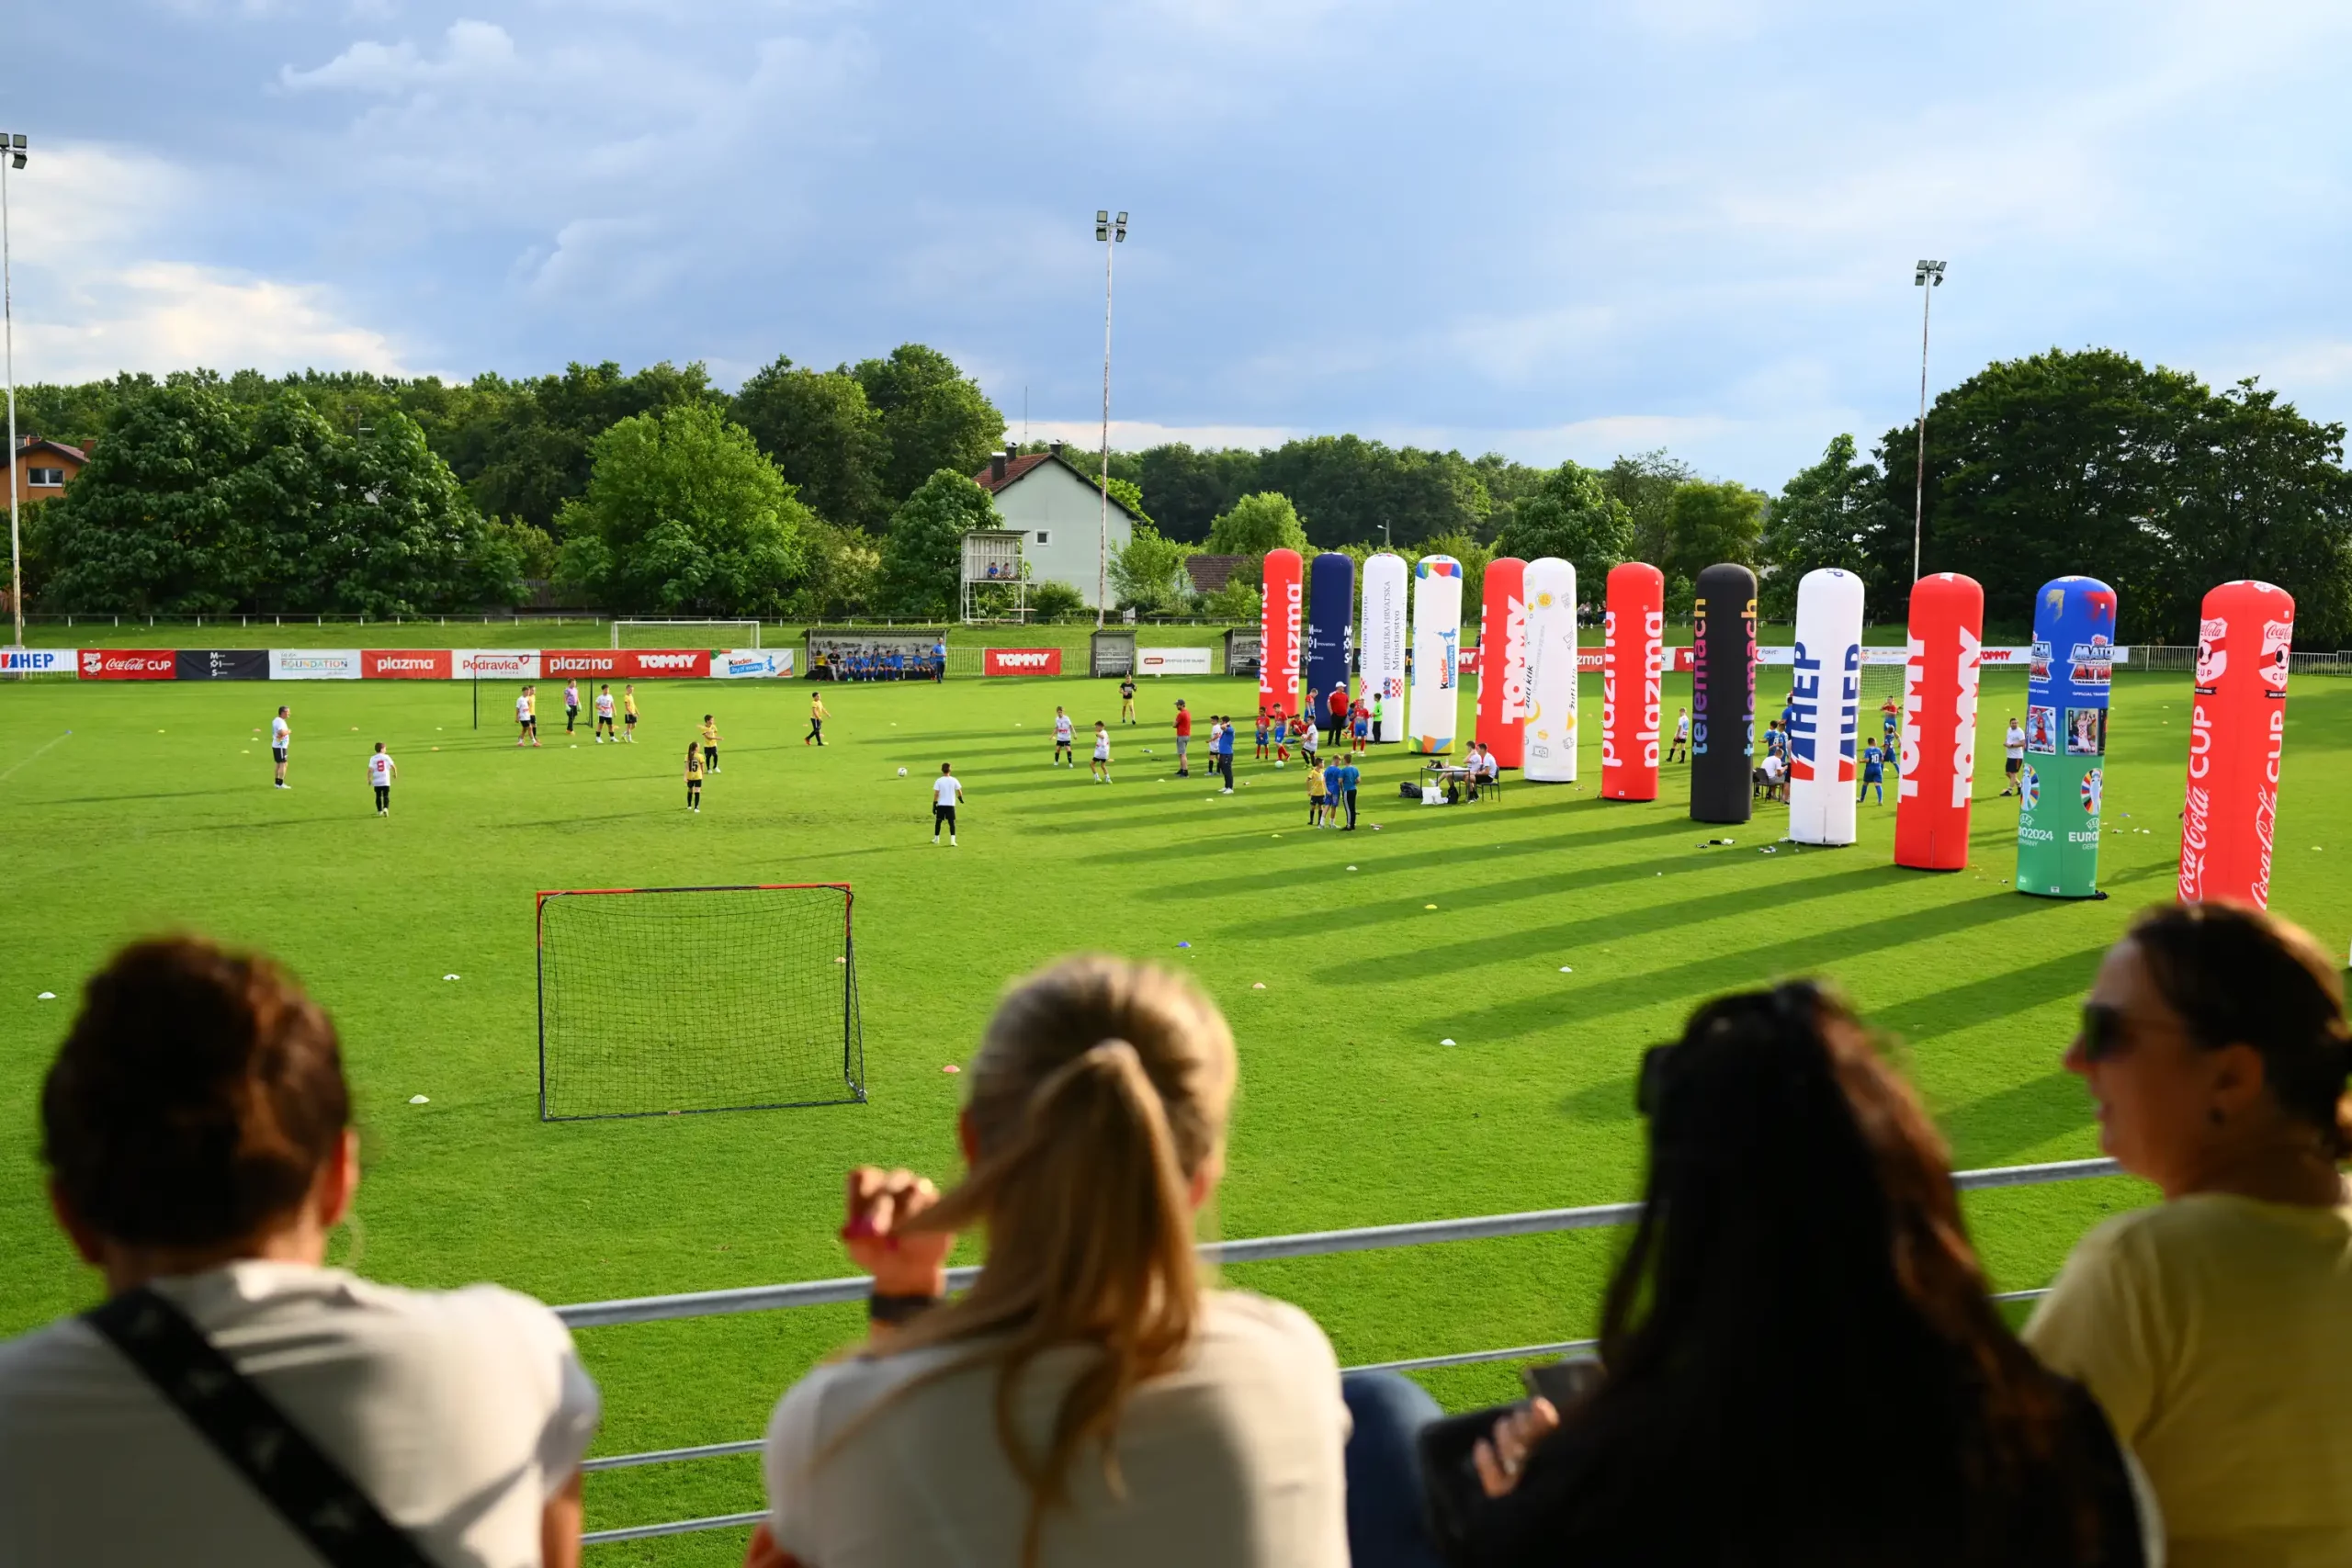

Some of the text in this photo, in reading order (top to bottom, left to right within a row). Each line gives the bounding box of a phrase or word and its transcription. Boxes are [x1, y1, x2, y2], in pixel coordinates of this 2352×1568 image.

[1392, 610, 1400, 671] Ministarstvo
[19, 653, 54, 668] HEP
[147, 660, 172, 671] CUP
[281, 659, 348, 668] FOUNDATION
[377, 656, 435, 673] plazma
[462, 660, 519, 671] Podravka
[549, 656, 613, 673] plazma
[637, 654, 697, 669] TOMMY
[996, 653, 1050, 667] TOMMY
[1692, 598, 1708, 756] telemach
[1741, 599, 1758, 757] telemach
[1636, 612, 1663, 768] plazma
[1791, 641, 1821, 734] HEP
[2189, 705, 2212, 779] CUP
